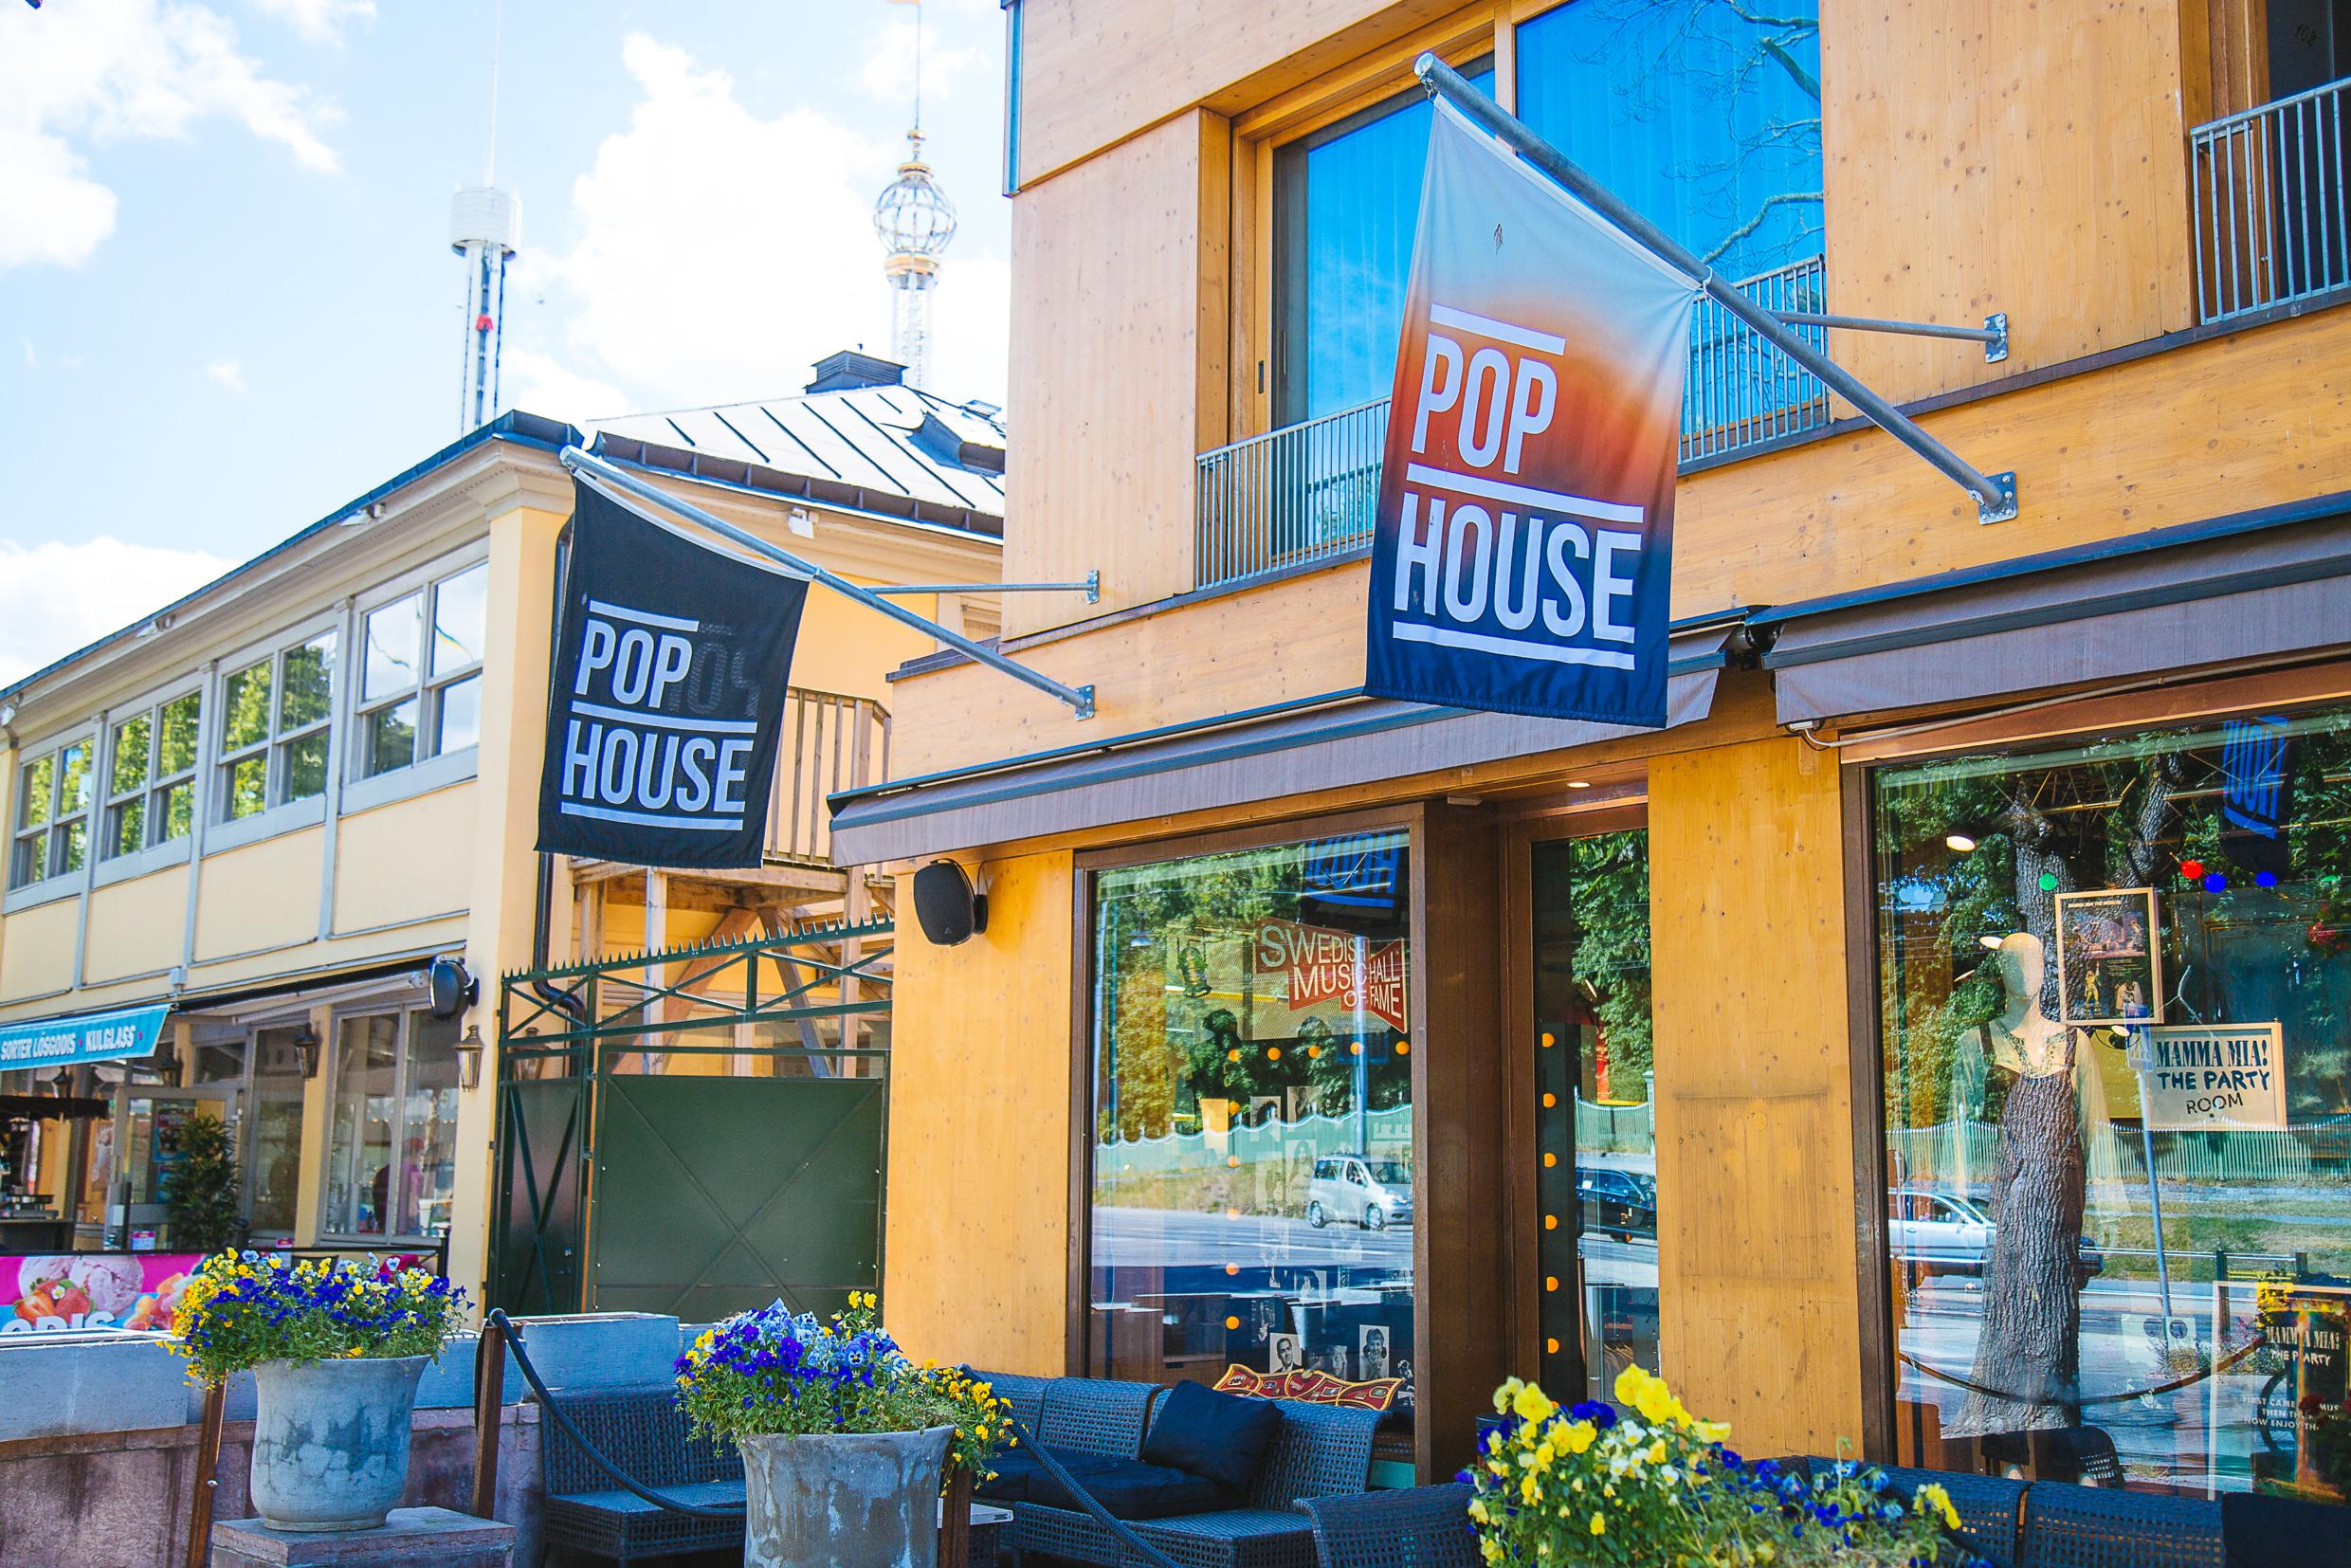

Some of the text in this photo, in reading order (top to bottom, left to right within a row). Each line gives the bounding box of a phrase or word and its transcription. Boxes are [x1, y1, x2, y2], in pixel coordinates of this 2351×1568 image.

[1411, 332, 1558, 475] POP
[1394, 491, 1642, 644] HOUSE
[574, 618, 693, 709] POP
[561, 719, 755, 813] HOUSE
[1260, 924, 1367, 968] SWEDISH
[1293, 950, 1401, 1001] MUSIC HALL
[1343, 982, 1402, 1019] OF FAME
[85, 1025, 137, 1052] KULGLASS
[2156, 1039, 2268, 1067] MAMMA MIA!
[2157, 1068, 2270, 1091] THE PARTY
[2186, 1092, 2243, 1115] ROOM
[2271, 1349, 2332, 1367] THE PARTY
[2242, 1396, 2268, 1405] FIRST
[2269, 1398, 2296, 1408] CAME
[2262, 1409, 2286, 1418] THEN
[2244, 1417, 2269, 1427] NOW
[2305, 1422, 2320, 1431] TH
